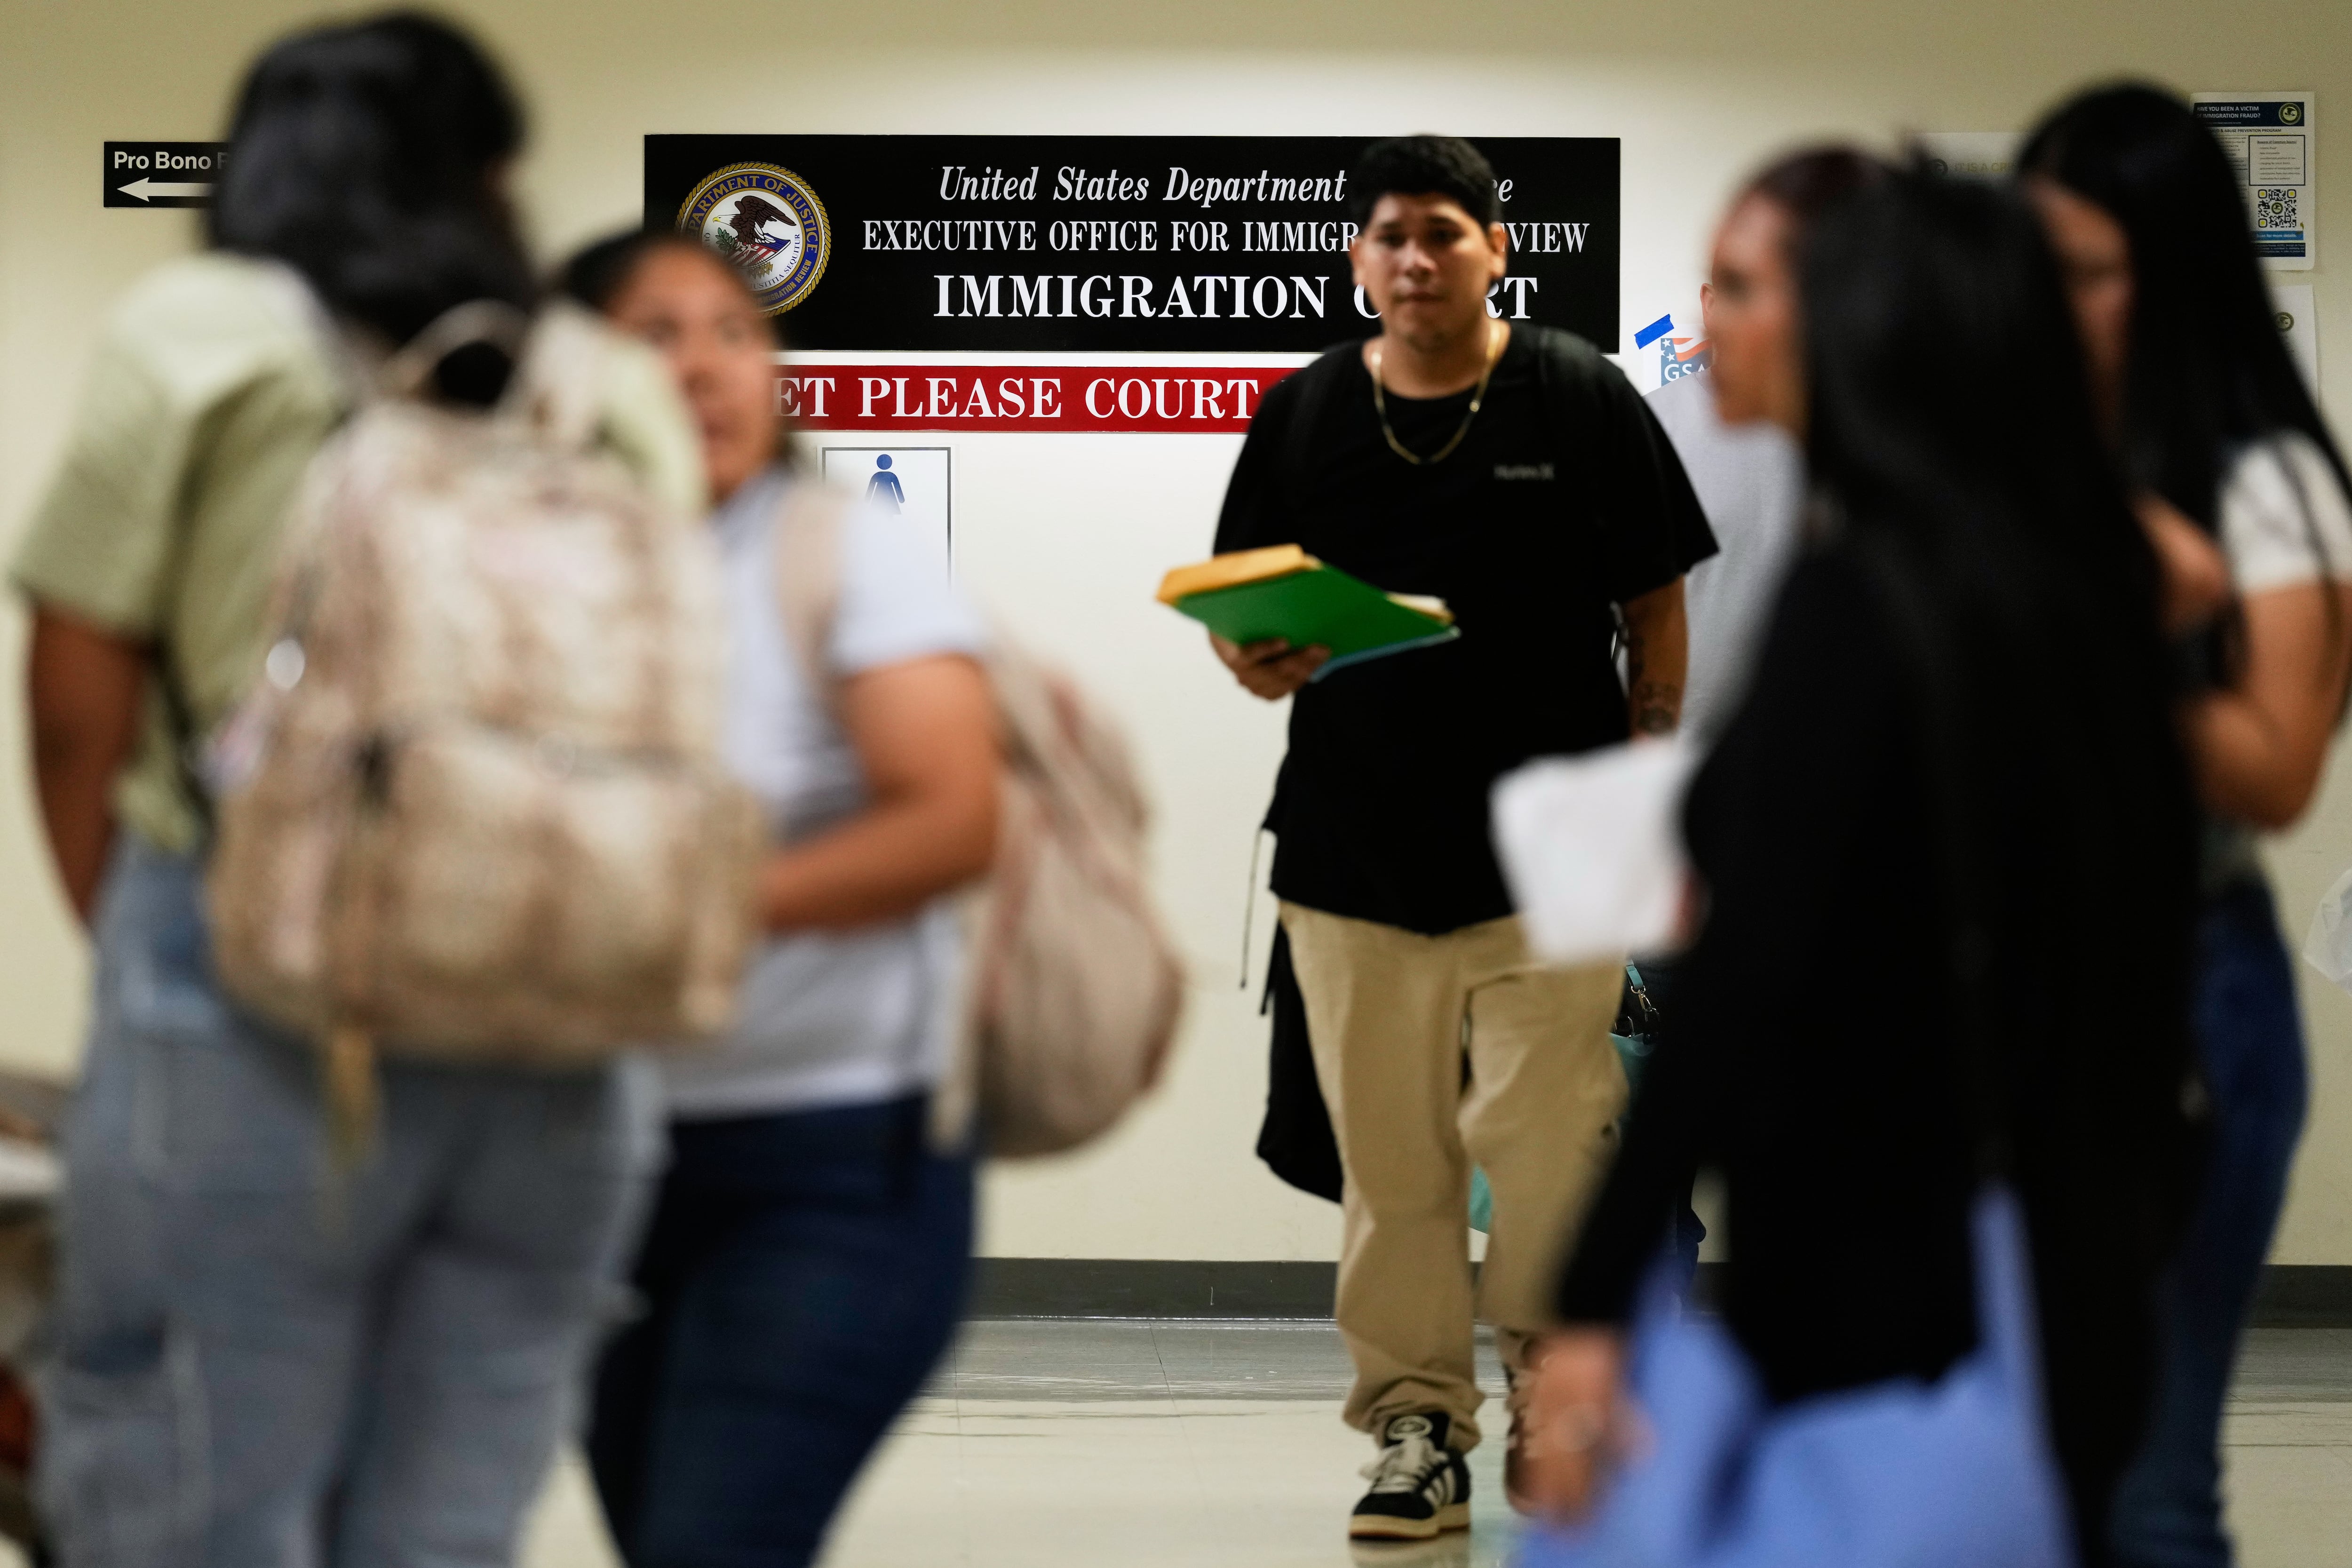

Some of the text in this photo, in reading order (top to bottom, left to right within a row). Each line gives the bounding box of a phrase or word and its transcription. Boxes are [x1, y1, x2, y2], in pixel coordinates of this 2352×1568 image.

[115, 151, 149, 169] Pro
[156, 151, 211, 169] Bono
[940, 167, 1347, 208] United States Department
[688, 175, 818, 253] PARTMENT OF JUSTICE
[784, 234, 800, 273] SEQUITUR
[862, 220, 1590, 253] EXECUTIVE OFFICE FOR IMMIGR VIEW
[795, 259, 812, 284] REVIEW
[933, 275, 1330, 318] IMMIGRATION
[858, 377, 1062, 418] PLEASE
[1085, 378, 1258, 419] COURT
